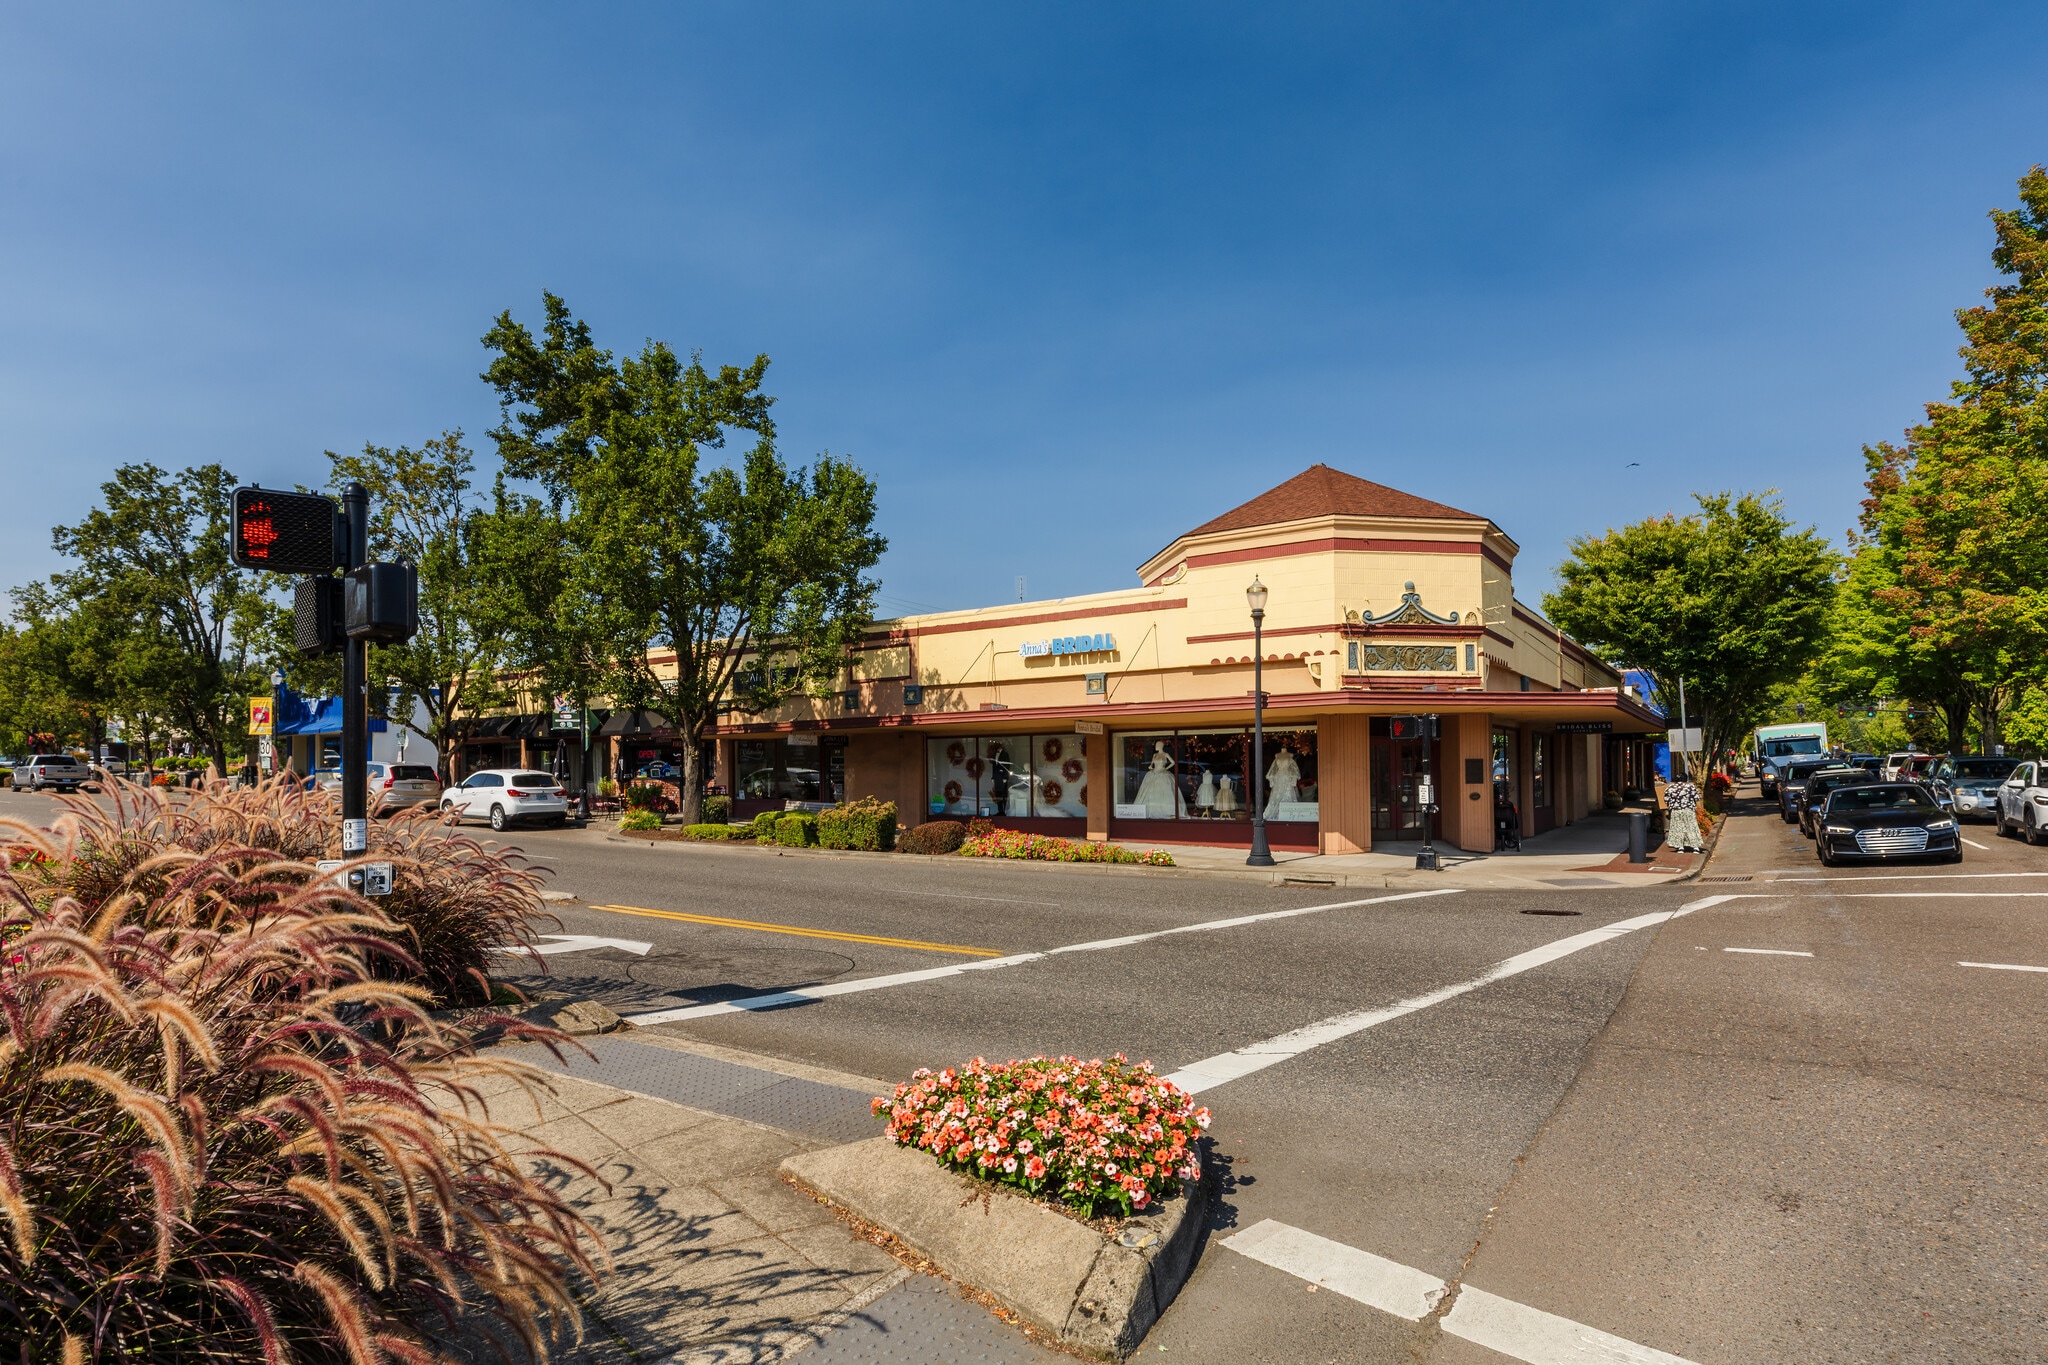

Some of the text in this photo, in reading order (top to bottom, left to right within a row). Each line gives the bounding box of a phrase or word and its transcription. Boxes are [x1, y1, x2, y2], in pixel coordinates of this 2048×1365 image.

[1019, 633, 1114, 656] Anna's BRIDAL
[260, 742, 271, 755] 30
[639, 750, 655, 759] OPEN
